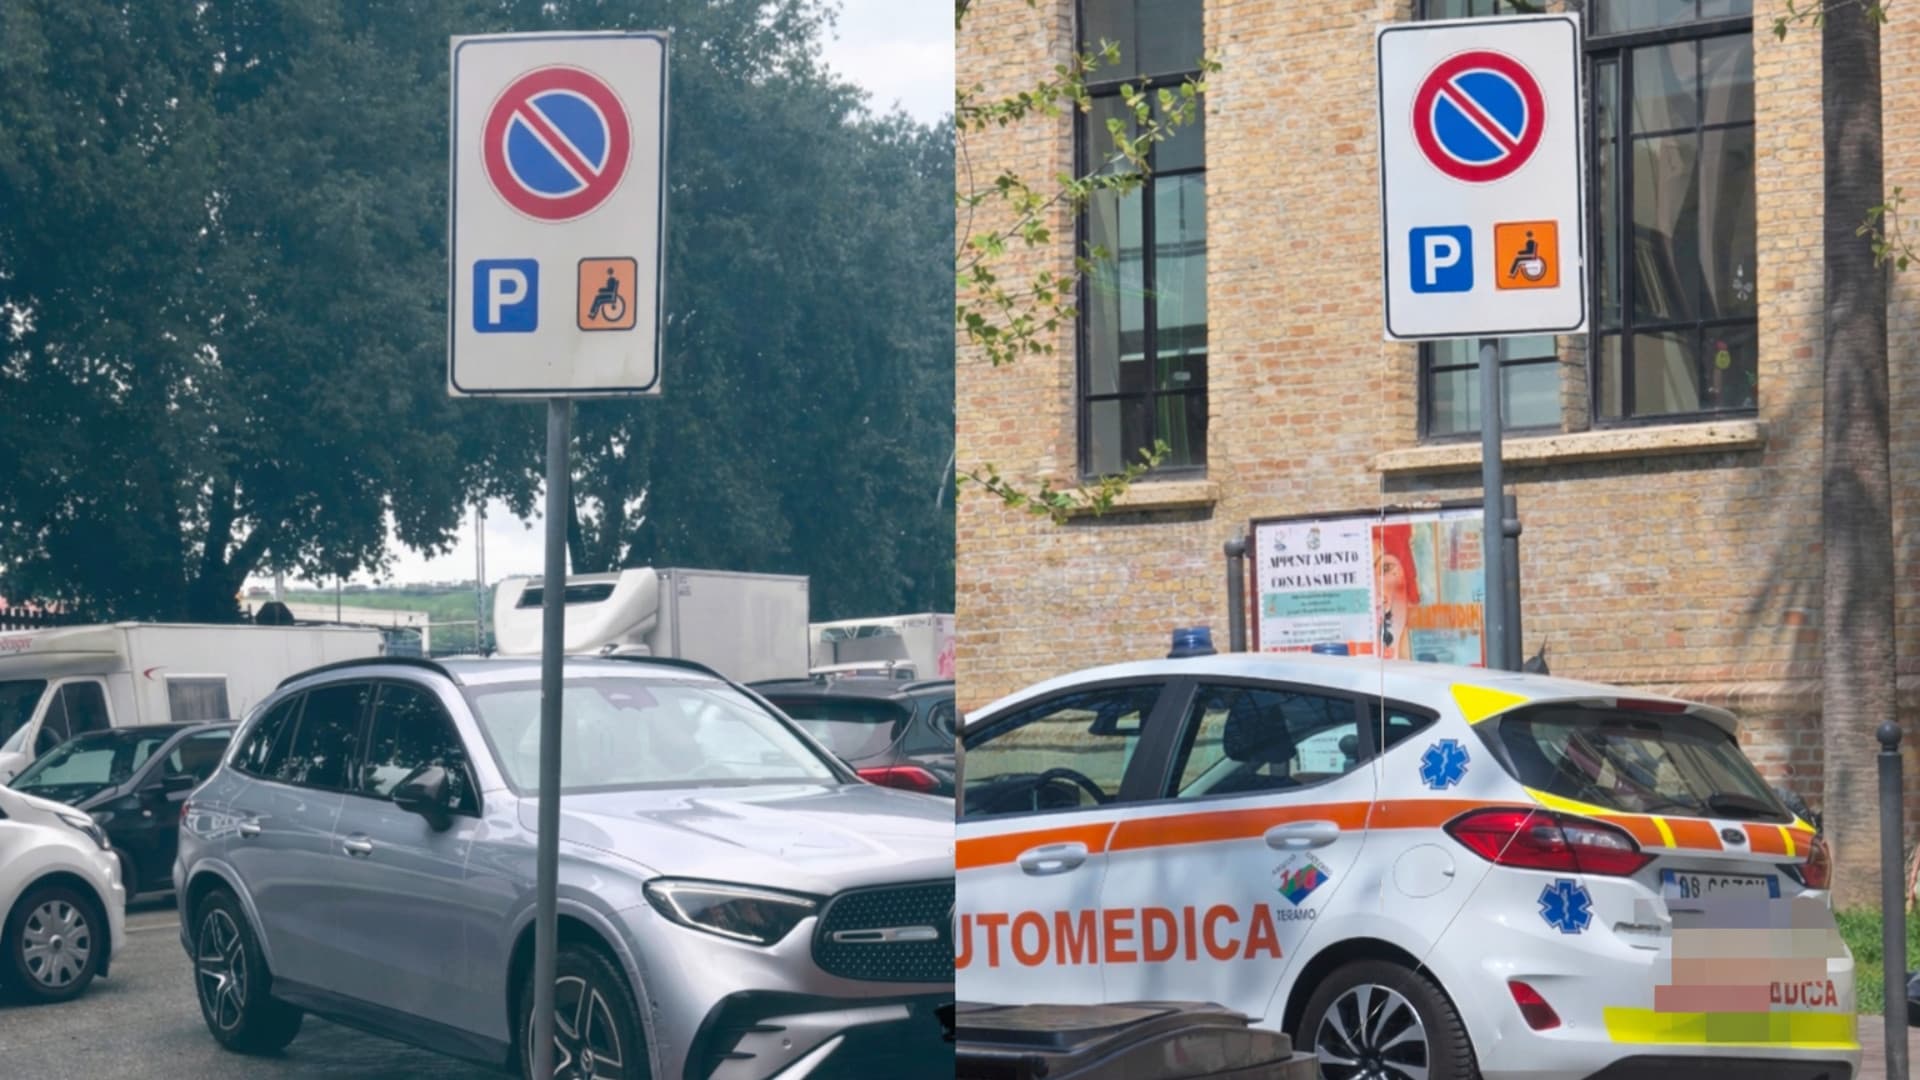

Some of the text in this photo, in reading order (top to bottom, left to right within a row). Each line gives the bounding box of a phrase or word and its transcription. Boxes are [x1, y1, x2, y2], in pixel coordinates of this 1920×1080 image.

[1424, 234, 1462, 285] P
[488, 268, 528, 325] P
[1270, 550, 1359, 569] APPUNTAMENTO
[1314, 571, 1357, 586] SALUTE
